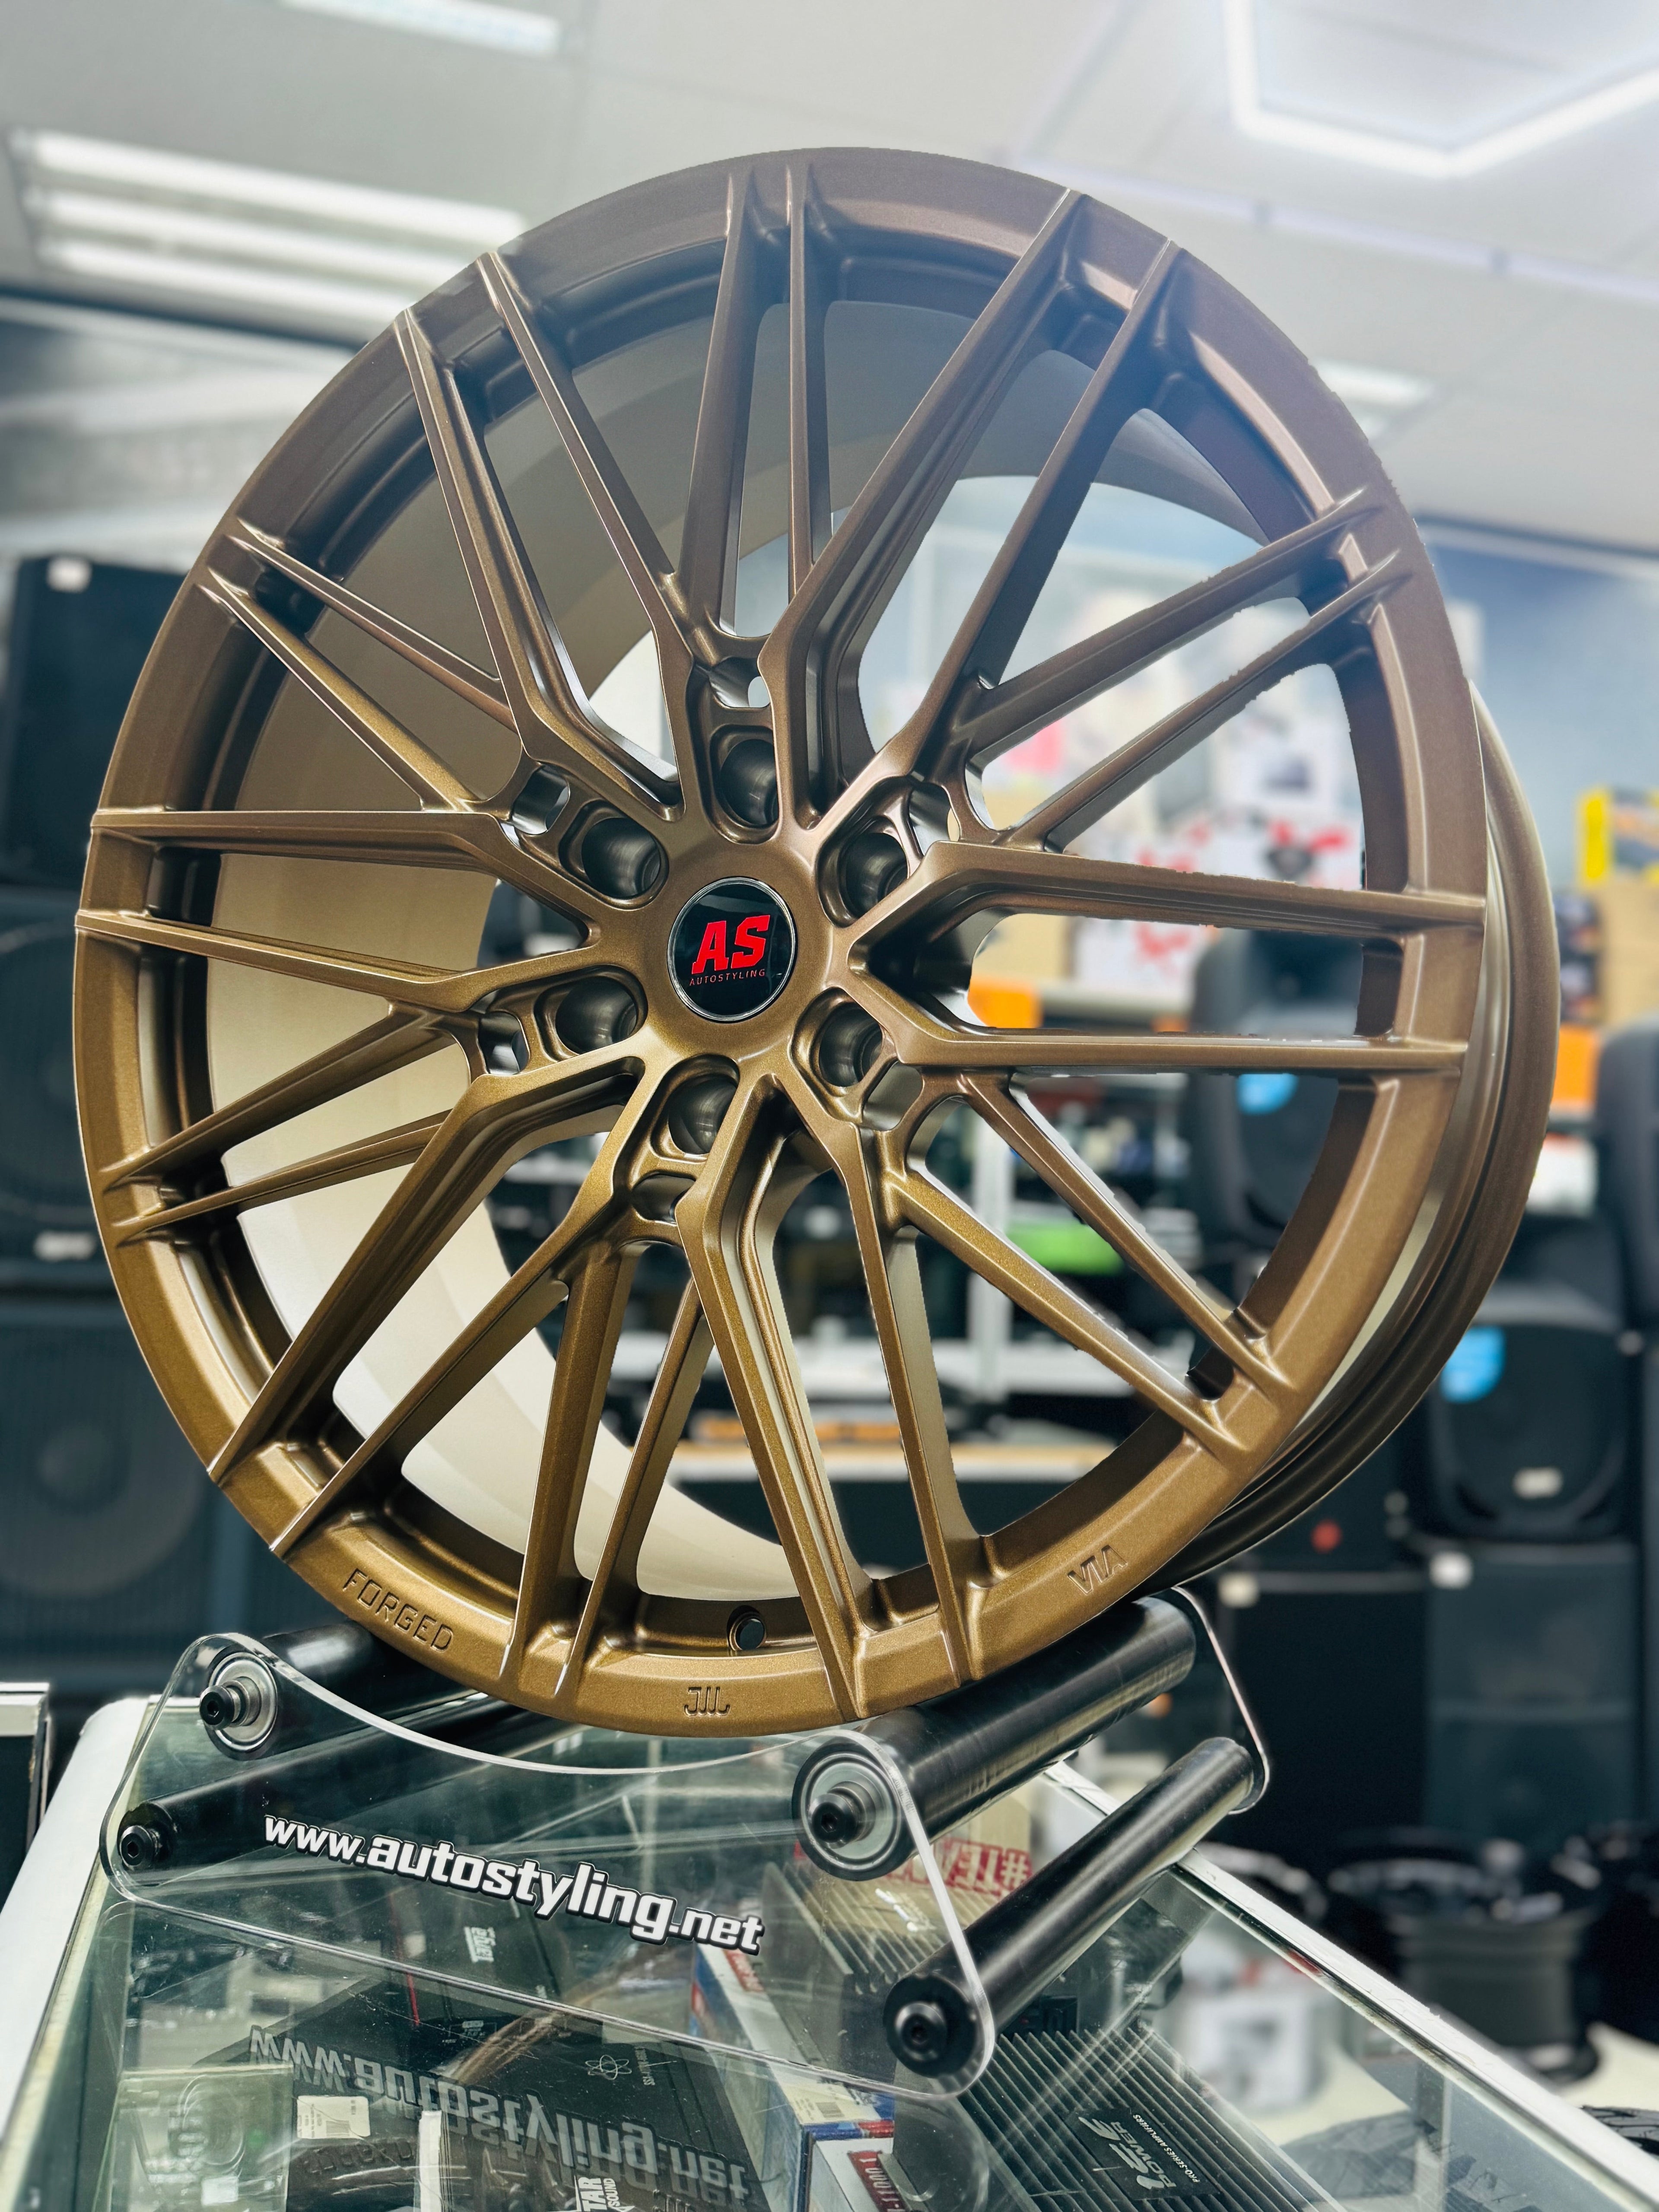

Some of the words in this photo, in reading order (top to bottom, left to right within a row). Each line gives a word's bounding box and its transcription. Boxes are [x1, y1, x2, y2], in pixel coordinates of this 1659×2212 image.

[691, 915, 771, 975] AS
[689, 969, 765, 986] AUTOSTYLING
[343, 1568, 454, 1653] FORGED
[264, 1815, 764, 1954] www.autostyling.net
[1111, 2121, 1176, 2187] POWER
[1133, 2114, 1168, 2149] AMPLIFIERS
[603, 2178, 620, 2207] SOUND
